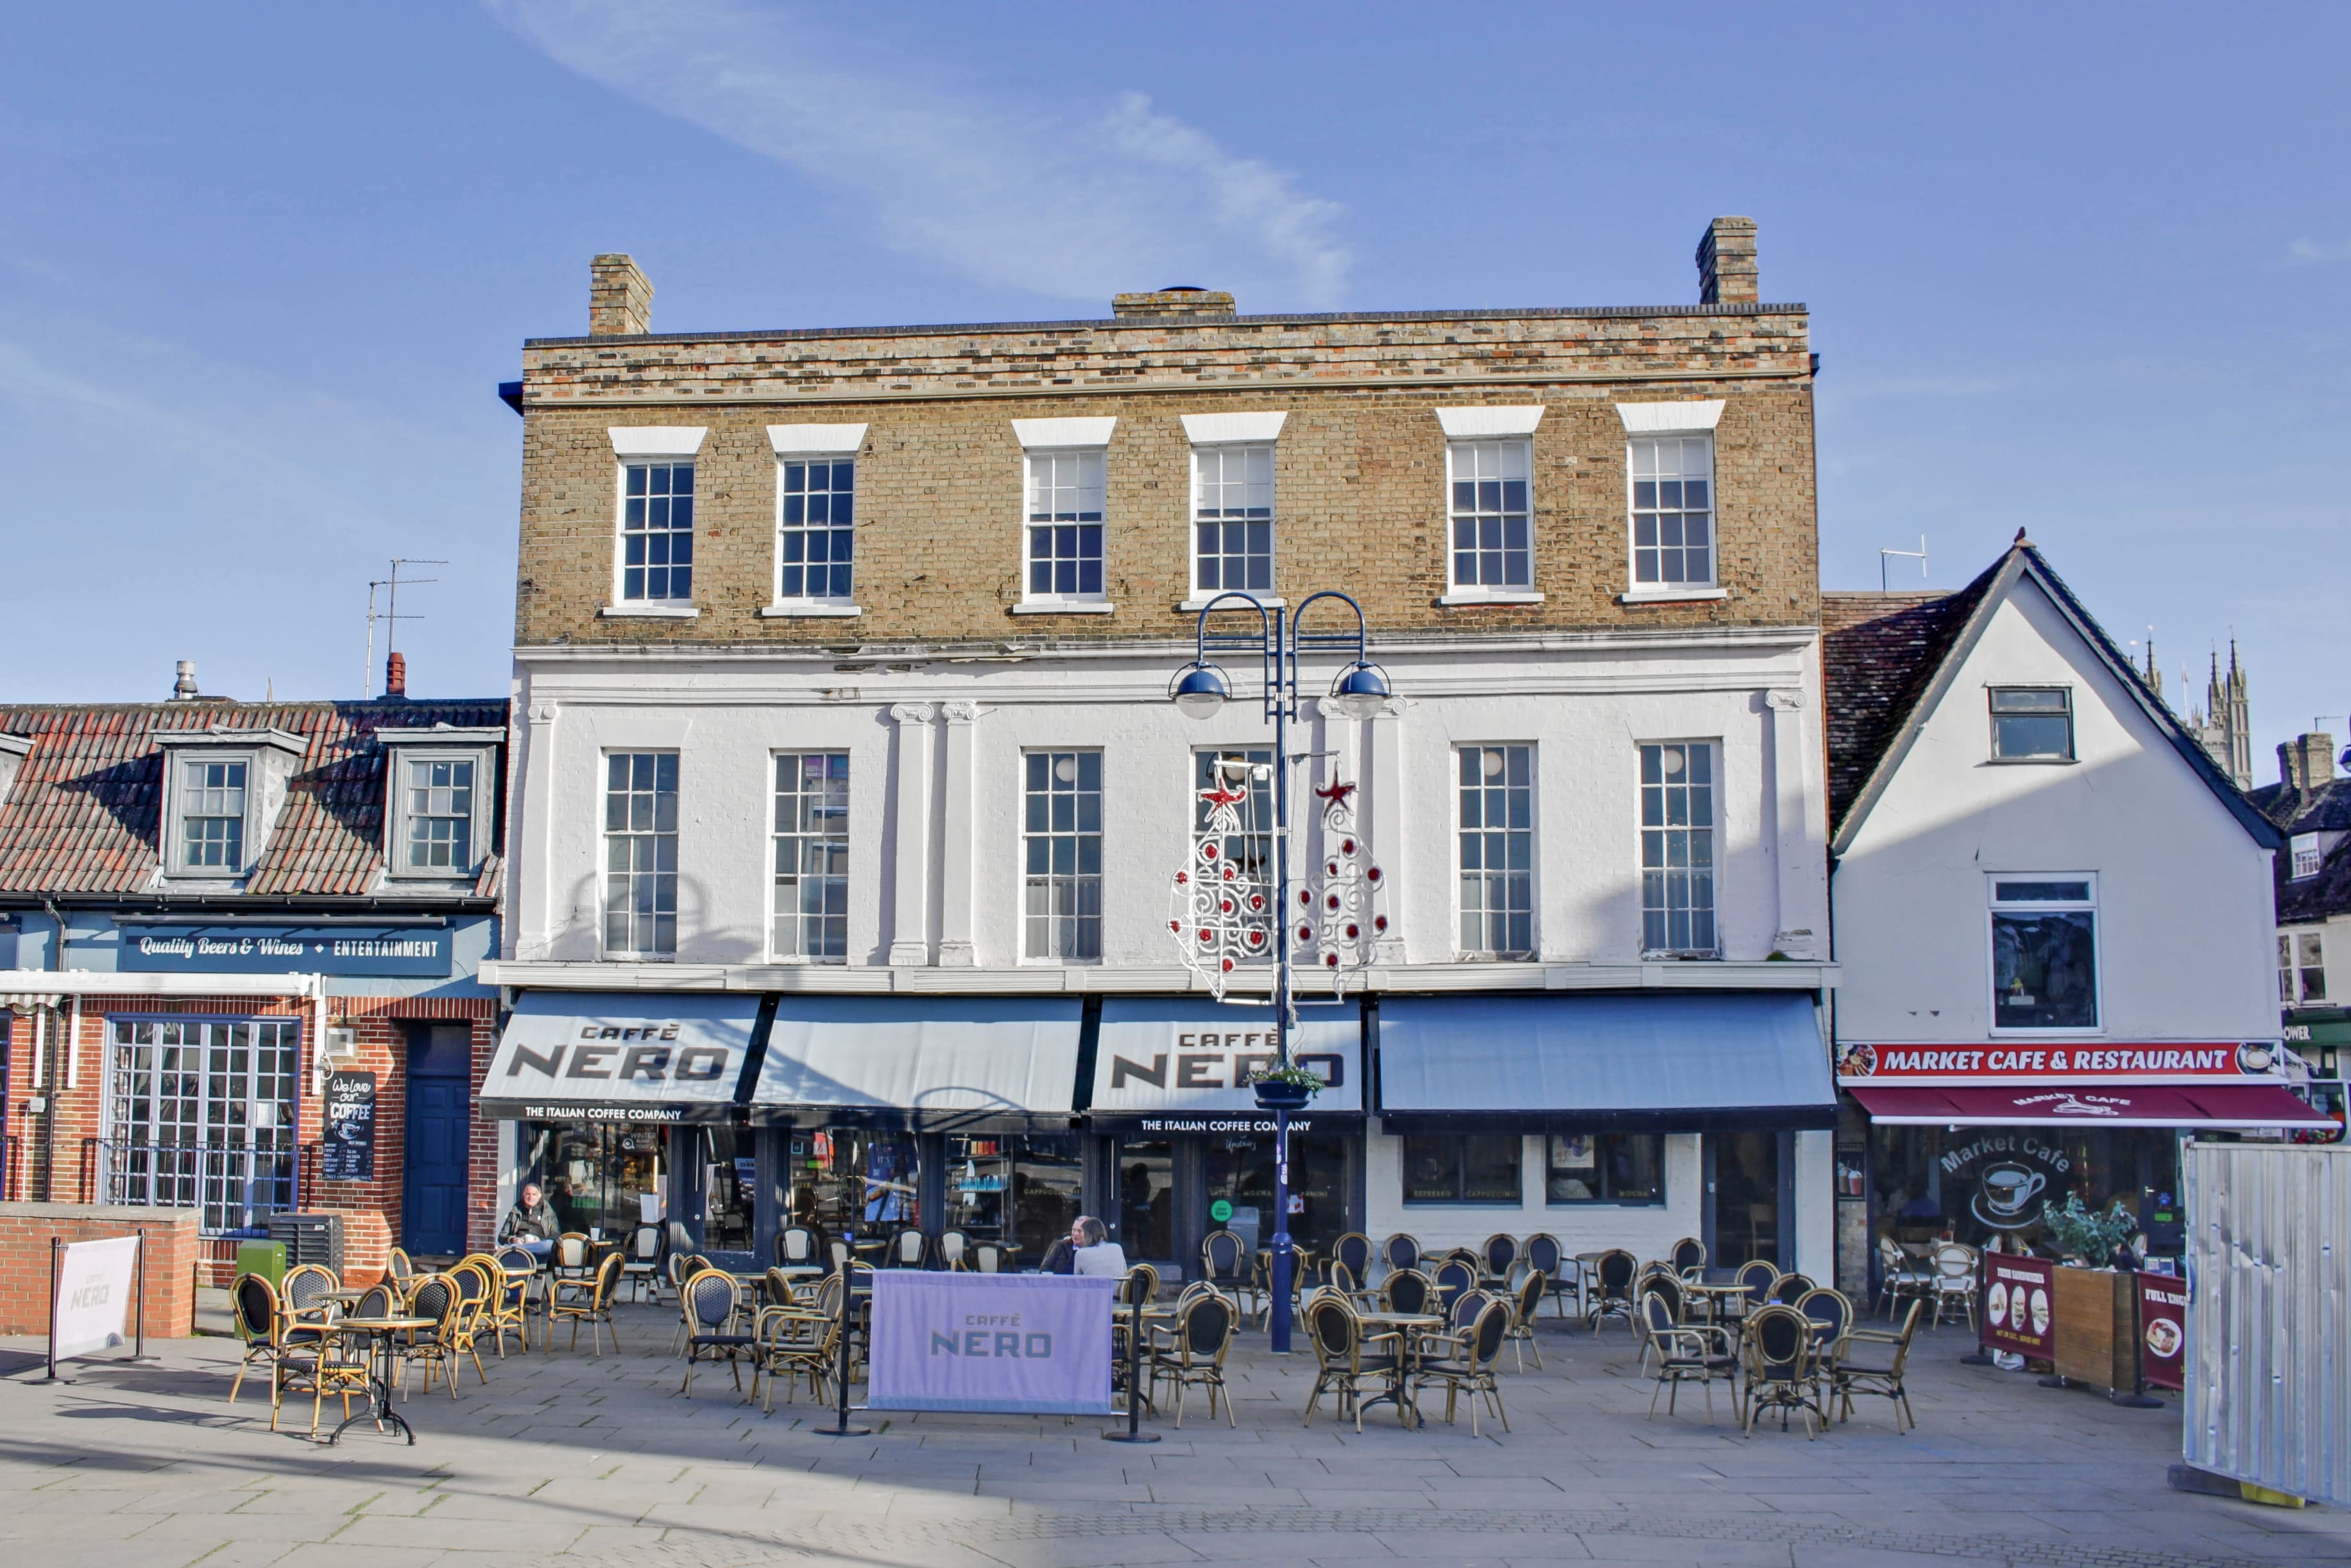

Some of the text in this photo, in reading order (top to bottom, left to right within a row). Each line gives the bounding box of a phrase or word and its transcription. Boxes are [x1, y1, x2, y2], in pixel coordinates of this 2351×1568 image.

[140, 937, 438, 959] Quality Beers & Wines ENTERTAINMENT
[580, 1023, 680, 1041] CAFFÈ
[1179, 1028, 1278, 1047] CAFFÈ
[2284, 1025, 2310, 1040] OWER
[506, 1043, 730, 1082] NERO
[1884, 1050, 2228, 1071] MARKET CAFE & RESTAURANT
[2012, 1093, 2131, 1106] MARKET CAFE
[525, 1107, 681, 1120] THE ITALIAN COFFEE COMPANY
[1141, 1120, 1311, 1132] THE ITALIAN COFFEE COMANY
[1940, 1135, 2070, 1173] Market Cafe
[71, 1284, 110, 1310] NERO
[2145, 1288, 2186, 1306] FULL ENG
[931, 1329, 1052, 1358] NERO
